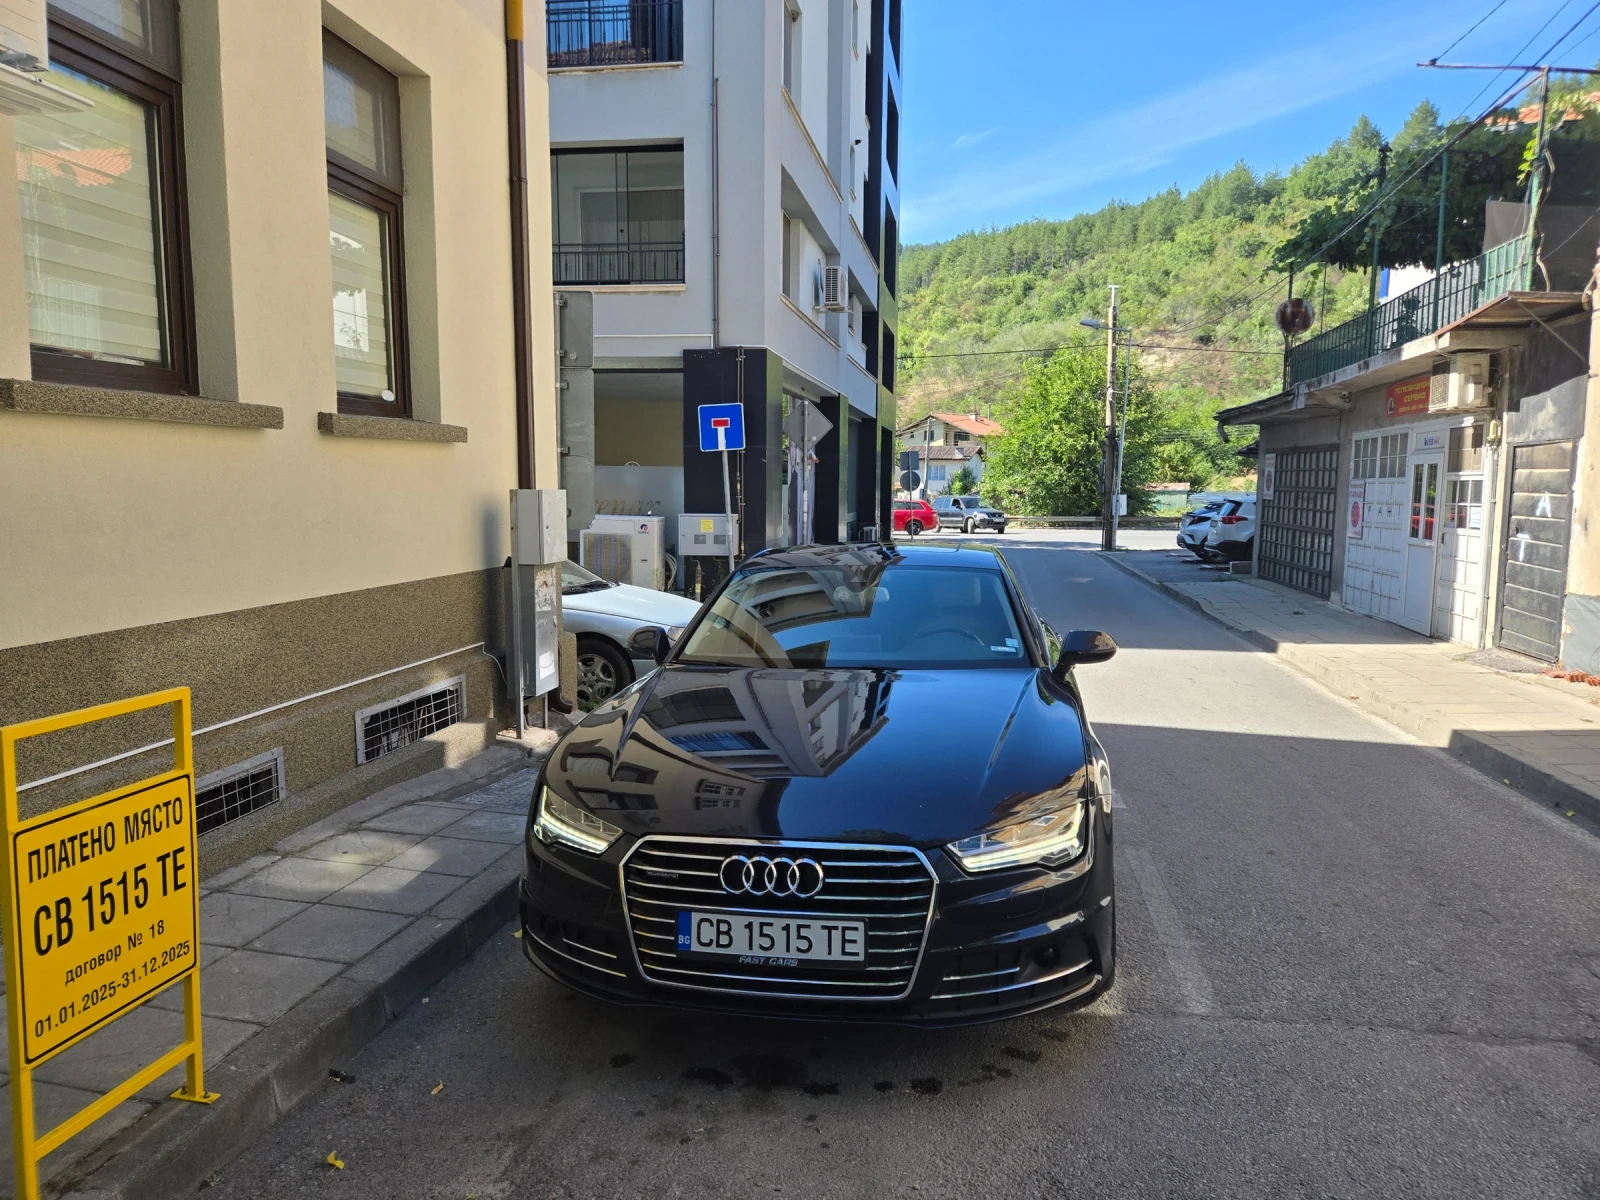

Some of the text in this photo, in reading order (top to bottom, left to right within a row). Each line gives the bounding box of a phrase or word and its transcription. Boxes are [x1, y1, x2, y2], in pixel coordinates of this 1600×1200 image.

[1404, 392, 1426, 402] СЕРВИЗ
[28, 796, 183, 884] ПЛАТЕНО МЯСТО
[33, 846, 187, 957] СВ 1515 ТЕ
[65, 919, 165, 987] договор № 18
[678, 934, 690, 945] BG
[696, 917, 860, 957] CB 1515 TE
[738, 955, 798, 967] FAST CARS
[34, 940, 190, 1038] 01.01.2025-31.12.2025
